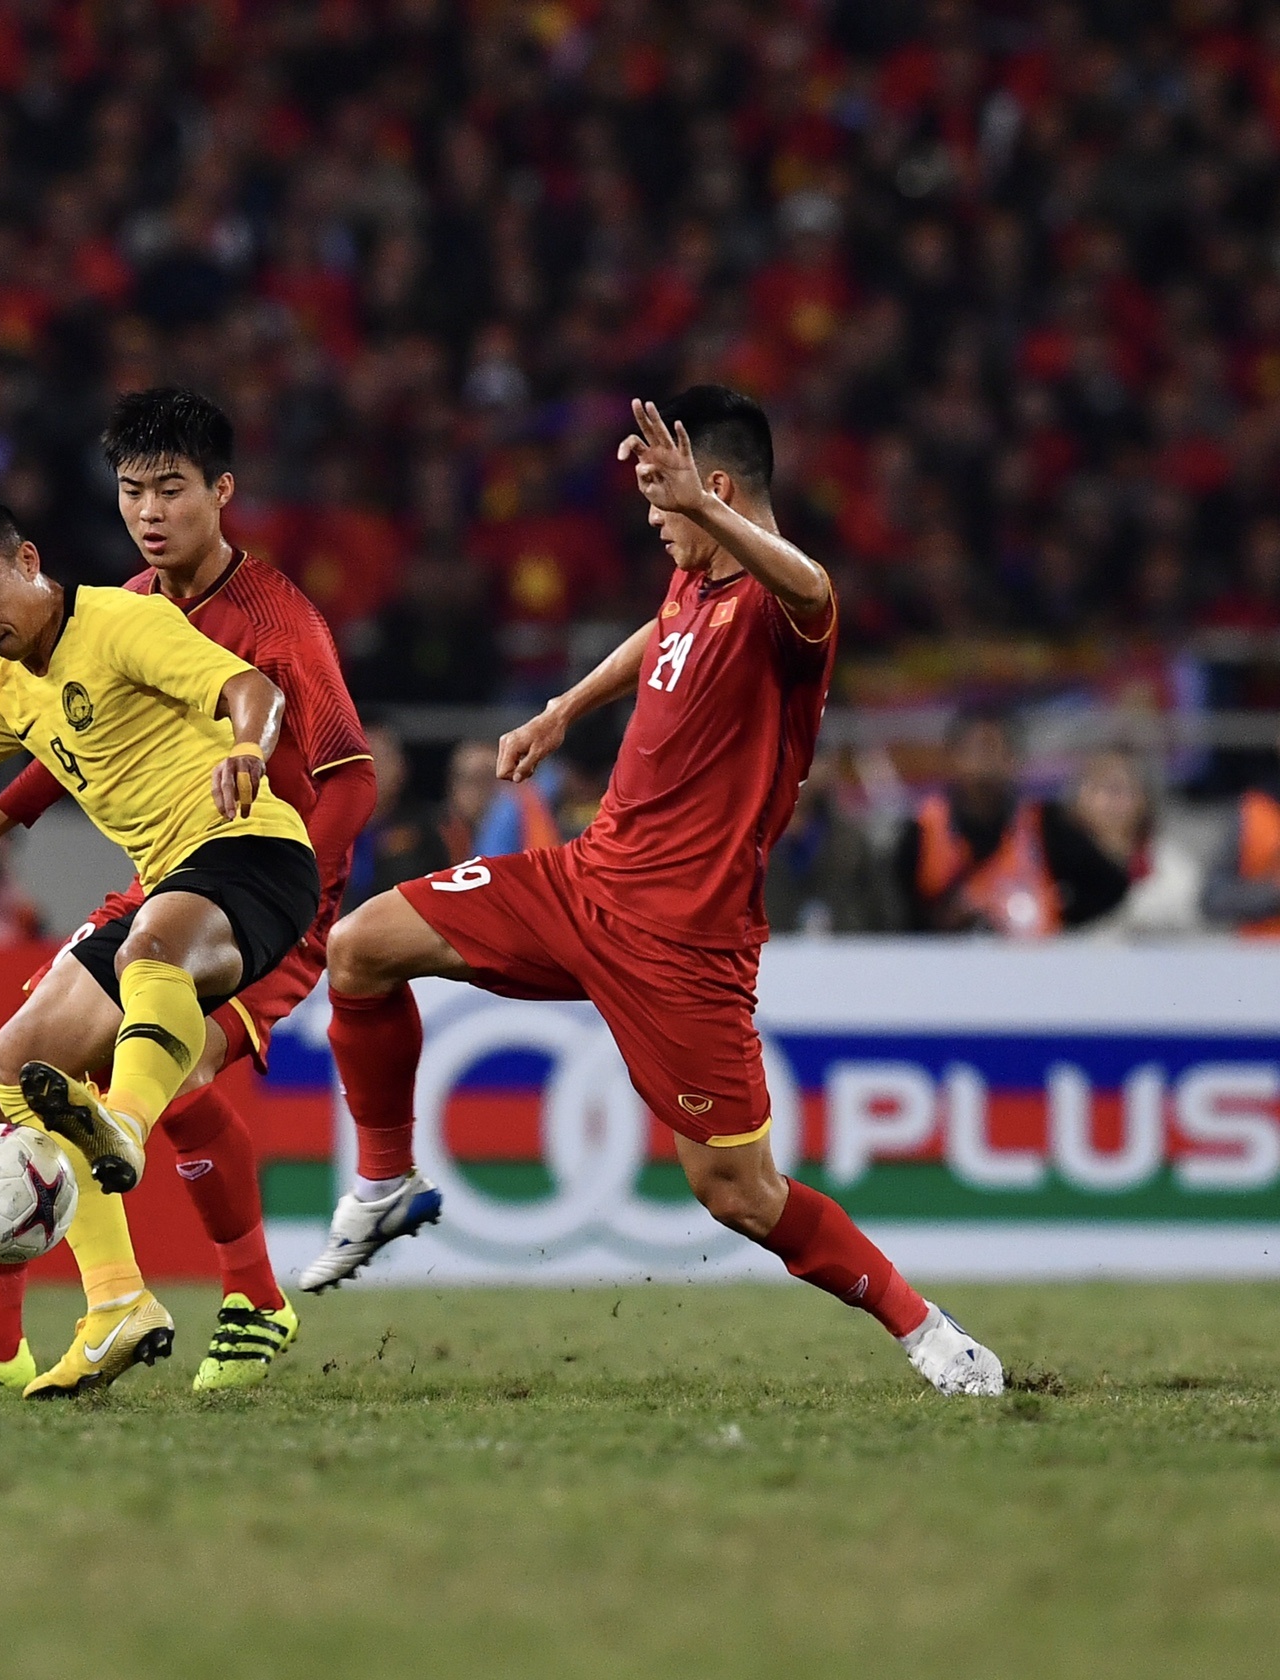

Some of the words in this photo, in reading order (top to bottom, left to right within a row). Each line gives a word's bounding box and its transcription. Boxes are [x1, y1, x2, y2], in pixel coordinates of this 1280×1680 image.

[647, 631, 695, 693] 29
[50, 736, 88, 793] 9
[424, 855, 492, 892] 9
[824, 1057, 1280, 1195] PLUS
